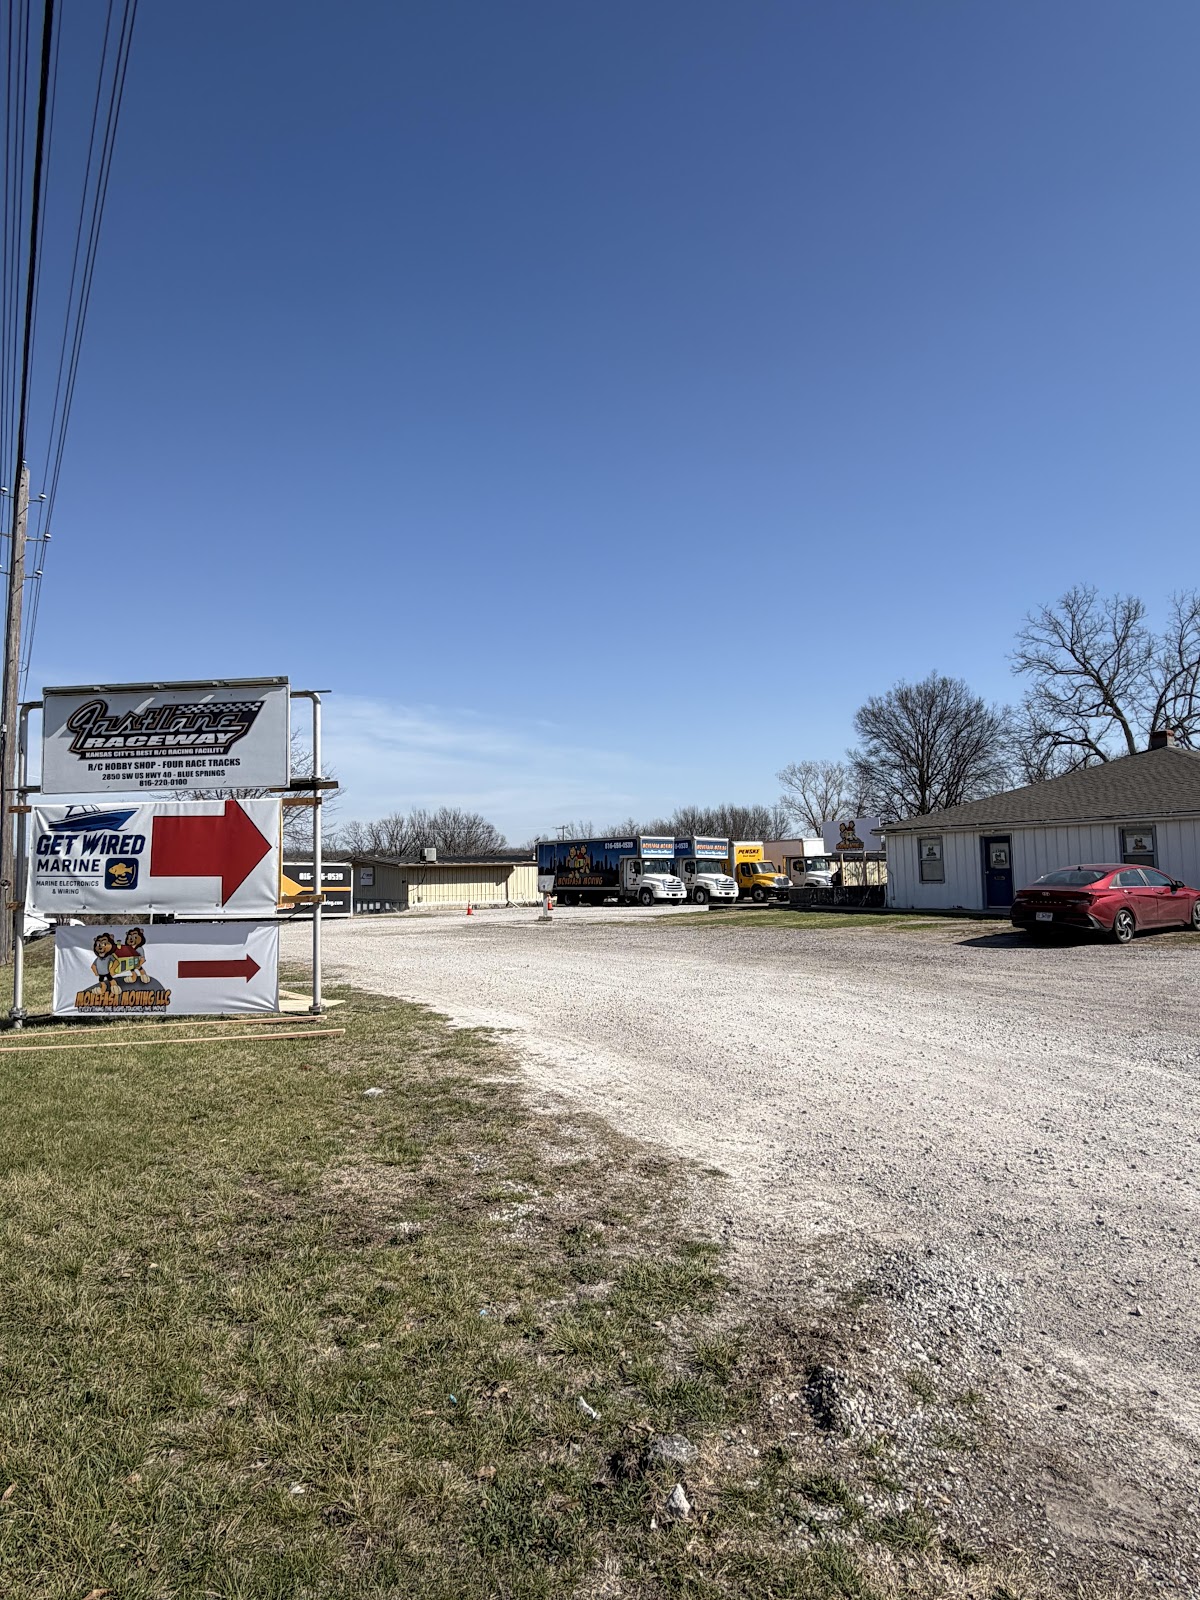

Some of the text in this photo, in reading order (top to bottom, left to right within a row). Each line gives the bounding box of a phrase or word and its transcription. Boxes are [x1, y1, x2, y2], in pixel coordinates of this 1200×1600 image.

[83, 732, 237, 749] RACEWAY
[87, 763, 104, 771] R/C
[105, 762, 132, 771] HOBBY
[134, 761, 156, 770] SHOP
[162, 760, 184, 769] FOUR
[185, 759, 206, 768] RACE
[208, 758, 241, 767] TRACKS
[121, 772, 134, 780] SW
[195, 769, 226, 777] SPRINGS
[139, 778, 188, 787] 816-220-0100
[36, 831, 146, 857] GET WIRED
[36, 859, 101, 872] MARINE
[299, 872, 343, 881] 816-6-0539
[75, 989, 171, 1007] MOVEFASA MOVING LLC
